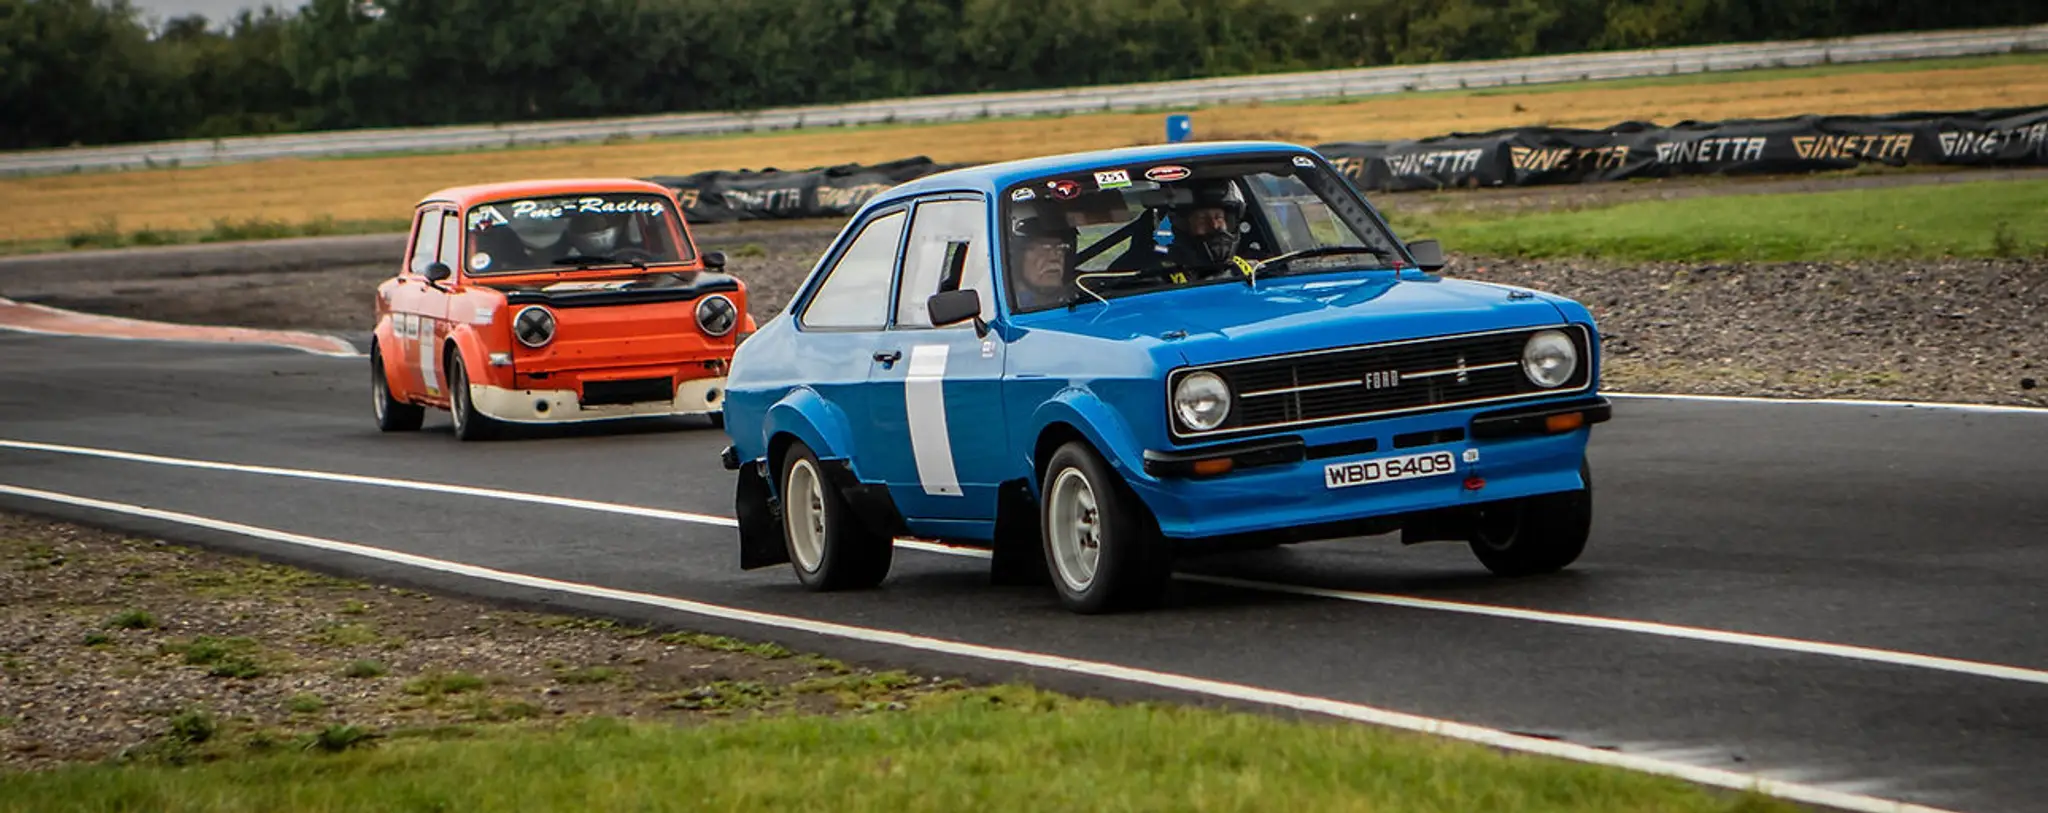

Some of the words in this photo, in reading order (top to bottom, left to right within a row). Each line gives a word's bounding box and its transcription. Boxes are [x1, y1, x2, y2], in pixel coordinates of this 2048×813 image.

[1653, 137, 1766, 163] GINETTA
[1791, 133, 1913, 159] GINETTA
[1384, 149, 1483, 176] GINETTA
[1099, 172, 1125, 183] 251
[1365, 370, 1399, 389] FORD
[1329, 462, 1381, 485] WBD
